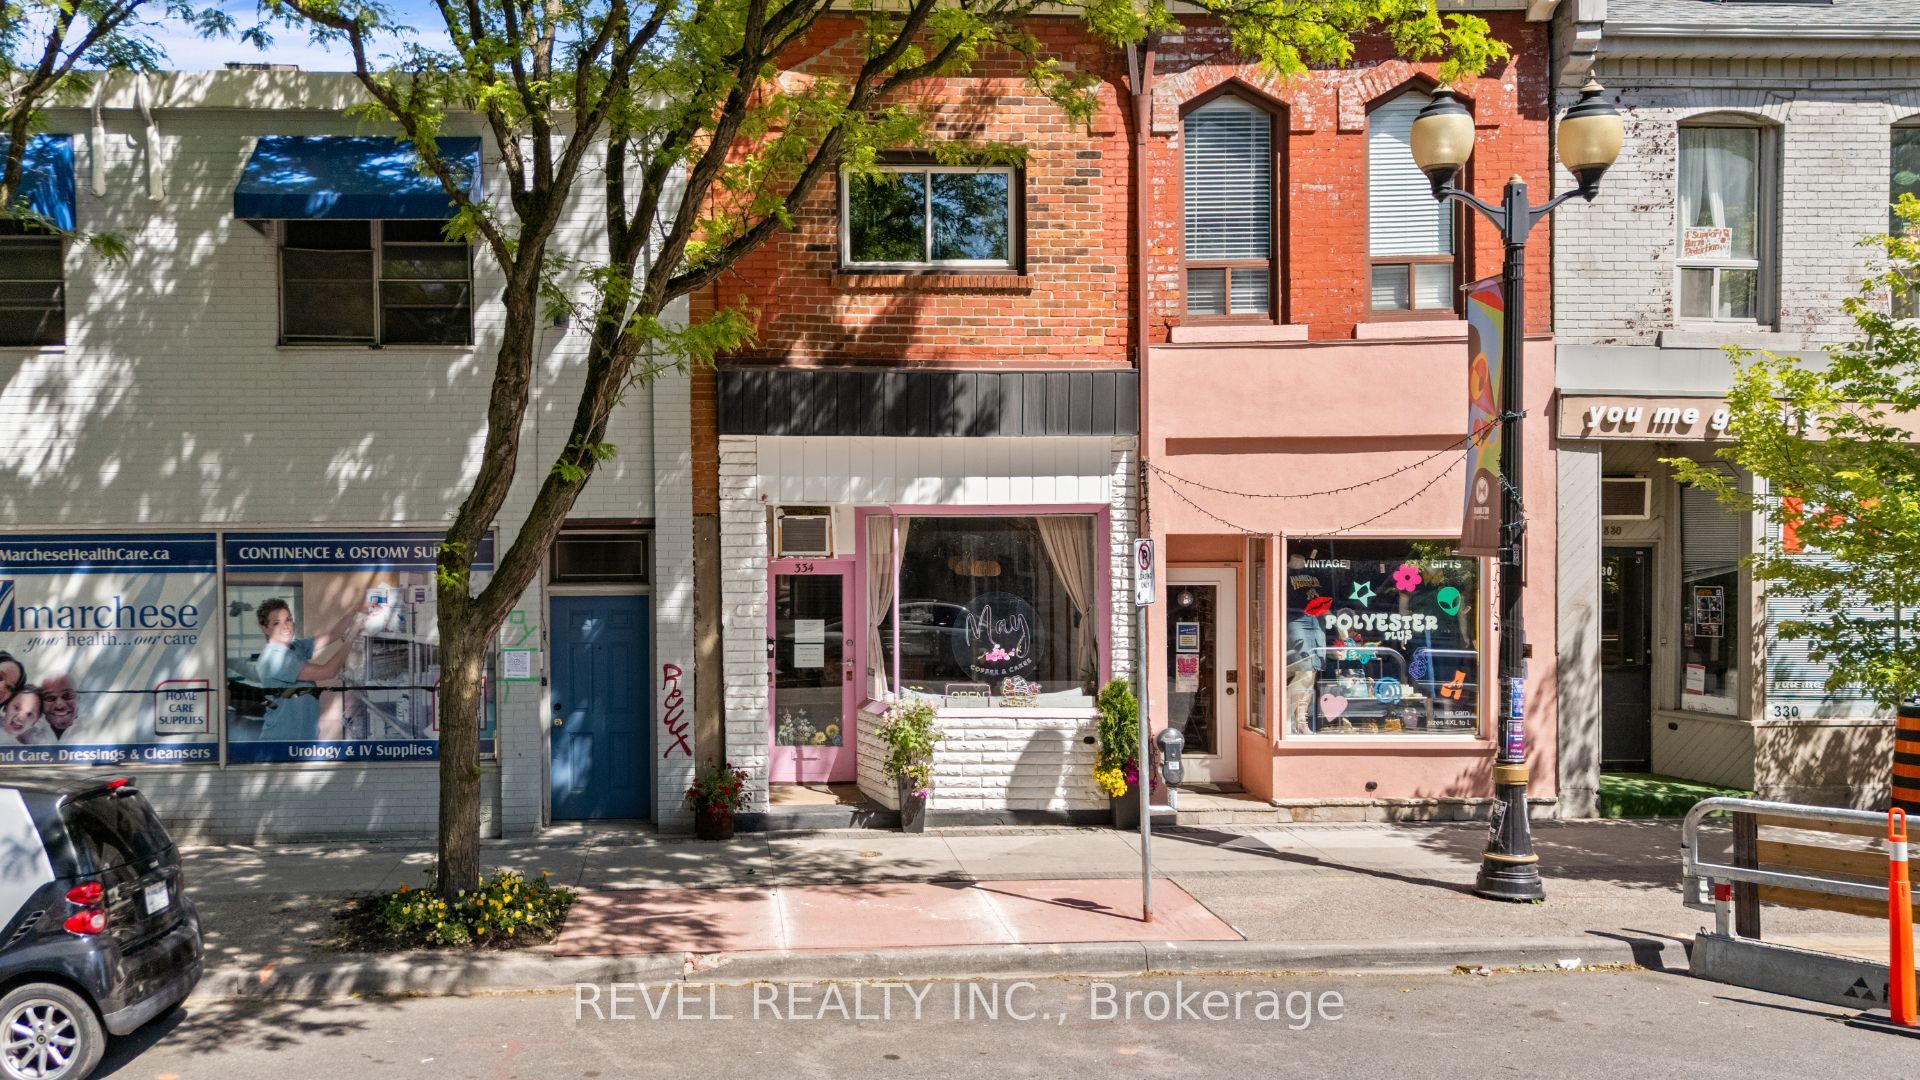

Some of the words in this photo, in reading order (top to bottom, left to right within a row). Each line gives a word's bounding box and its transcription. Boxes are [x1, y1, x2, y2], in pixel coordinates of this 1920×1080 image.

[1587, 405, 1644, 428] you
[1653, 406, 1699, 424] me
[0, 547, 170, 561] MarcheseHealthCare.ca
[239, 546, 330, 560] CONTINENCE
[335, 547, 345, 559] &
[350, 546, 410, 559] OSTOMY
[794, 562, 814, 574] 334
[1303, 559, 1347, 569] VINTAGE
[1431, 559, 1462, 569] GIFTS
[17, 595, 198, 629] marchese
[1324, 612, 1439, 632] POLYESTER
[966, 605, 1031, 659] May
[1385, 629, 1413, 643] PLUS
[23, 636, 65, 653] your
[67, 632, 131, 646] health...
[134, 634, 162, 646] our
[163, 633, 198, 646] care
[970, 664, 999, 676] COFFEE
[1009, 658, 1033, 673] CAKES
[165, 691, 198, 701] HOME
[168, 703, 194, 713] CARE
[1774, 705, 1799, 718] 330
[158, 715, 204, 725] SUPPLIES
[18, 749, 54, 763] Care,
[58, 749, 126, 763] Dressings
[130, 749, 140, 760] &
[144, 747, 211, 760] Cleansers
[288, 745, 341, 759] Urology
[345, 745, 355, 757] &
[359, 744, 372, 756] IV
[376, 744, 433, 759] Supplies
